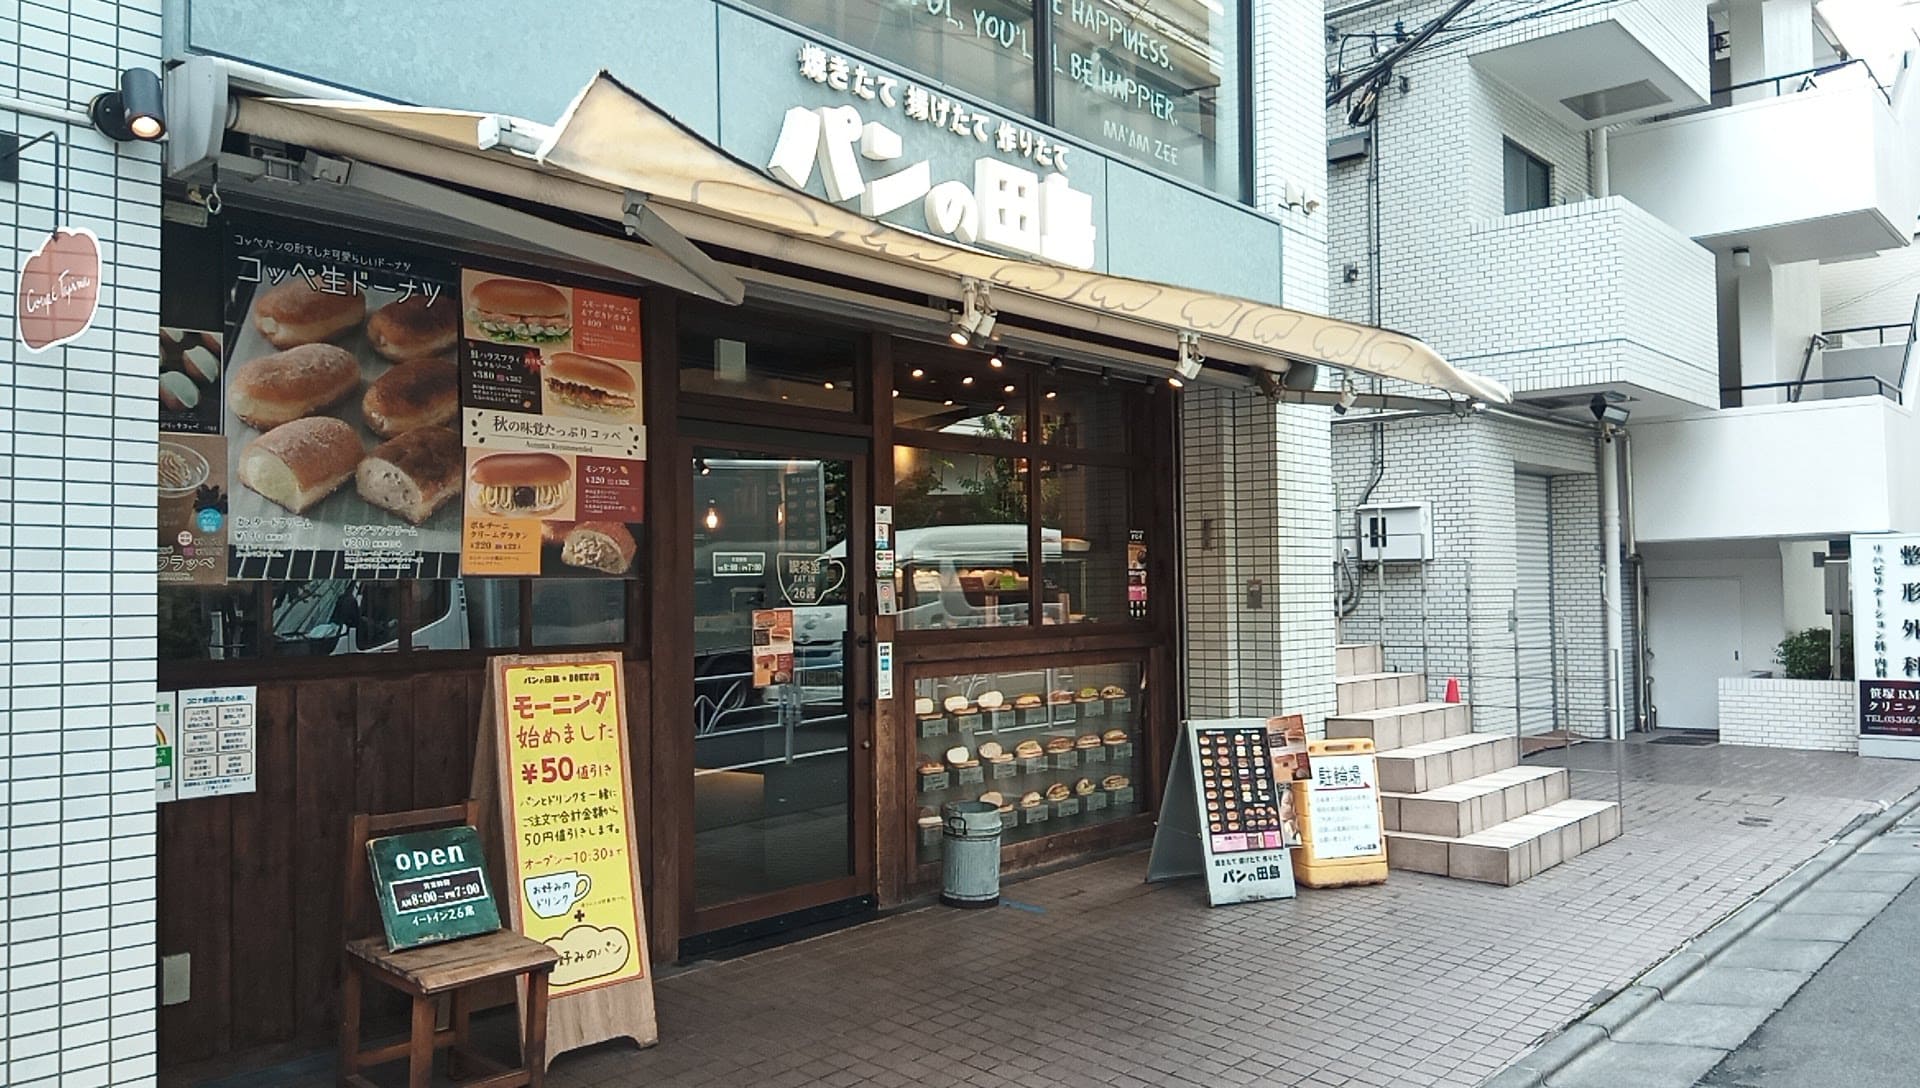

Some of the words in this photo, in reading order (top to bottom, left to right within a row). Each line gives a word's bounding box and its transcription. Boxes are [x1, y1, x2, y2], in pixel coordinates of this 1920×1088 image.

[1071, 53, 1093, 86] BE
[798, 42, 898, 108] 焼きたて
[904, 84, 989, 143] 揚げたて
[994, 121, 1070, 172] 作りたて
[1155, 140, 1178, 165] ZEE
[237, 255, 441, 308] コッペ生ドーナツ
[492, 415, 623, 440] 秋の味覚たっぷりコッペ
[585, 465, 618, 474] モンブラン
[513, 690, 612, 719] モーニング
[516, 722, 614, 749] 始めました
[395, 845, 465, 871] open
[1223, 864, 1281, 884] パンの田島
